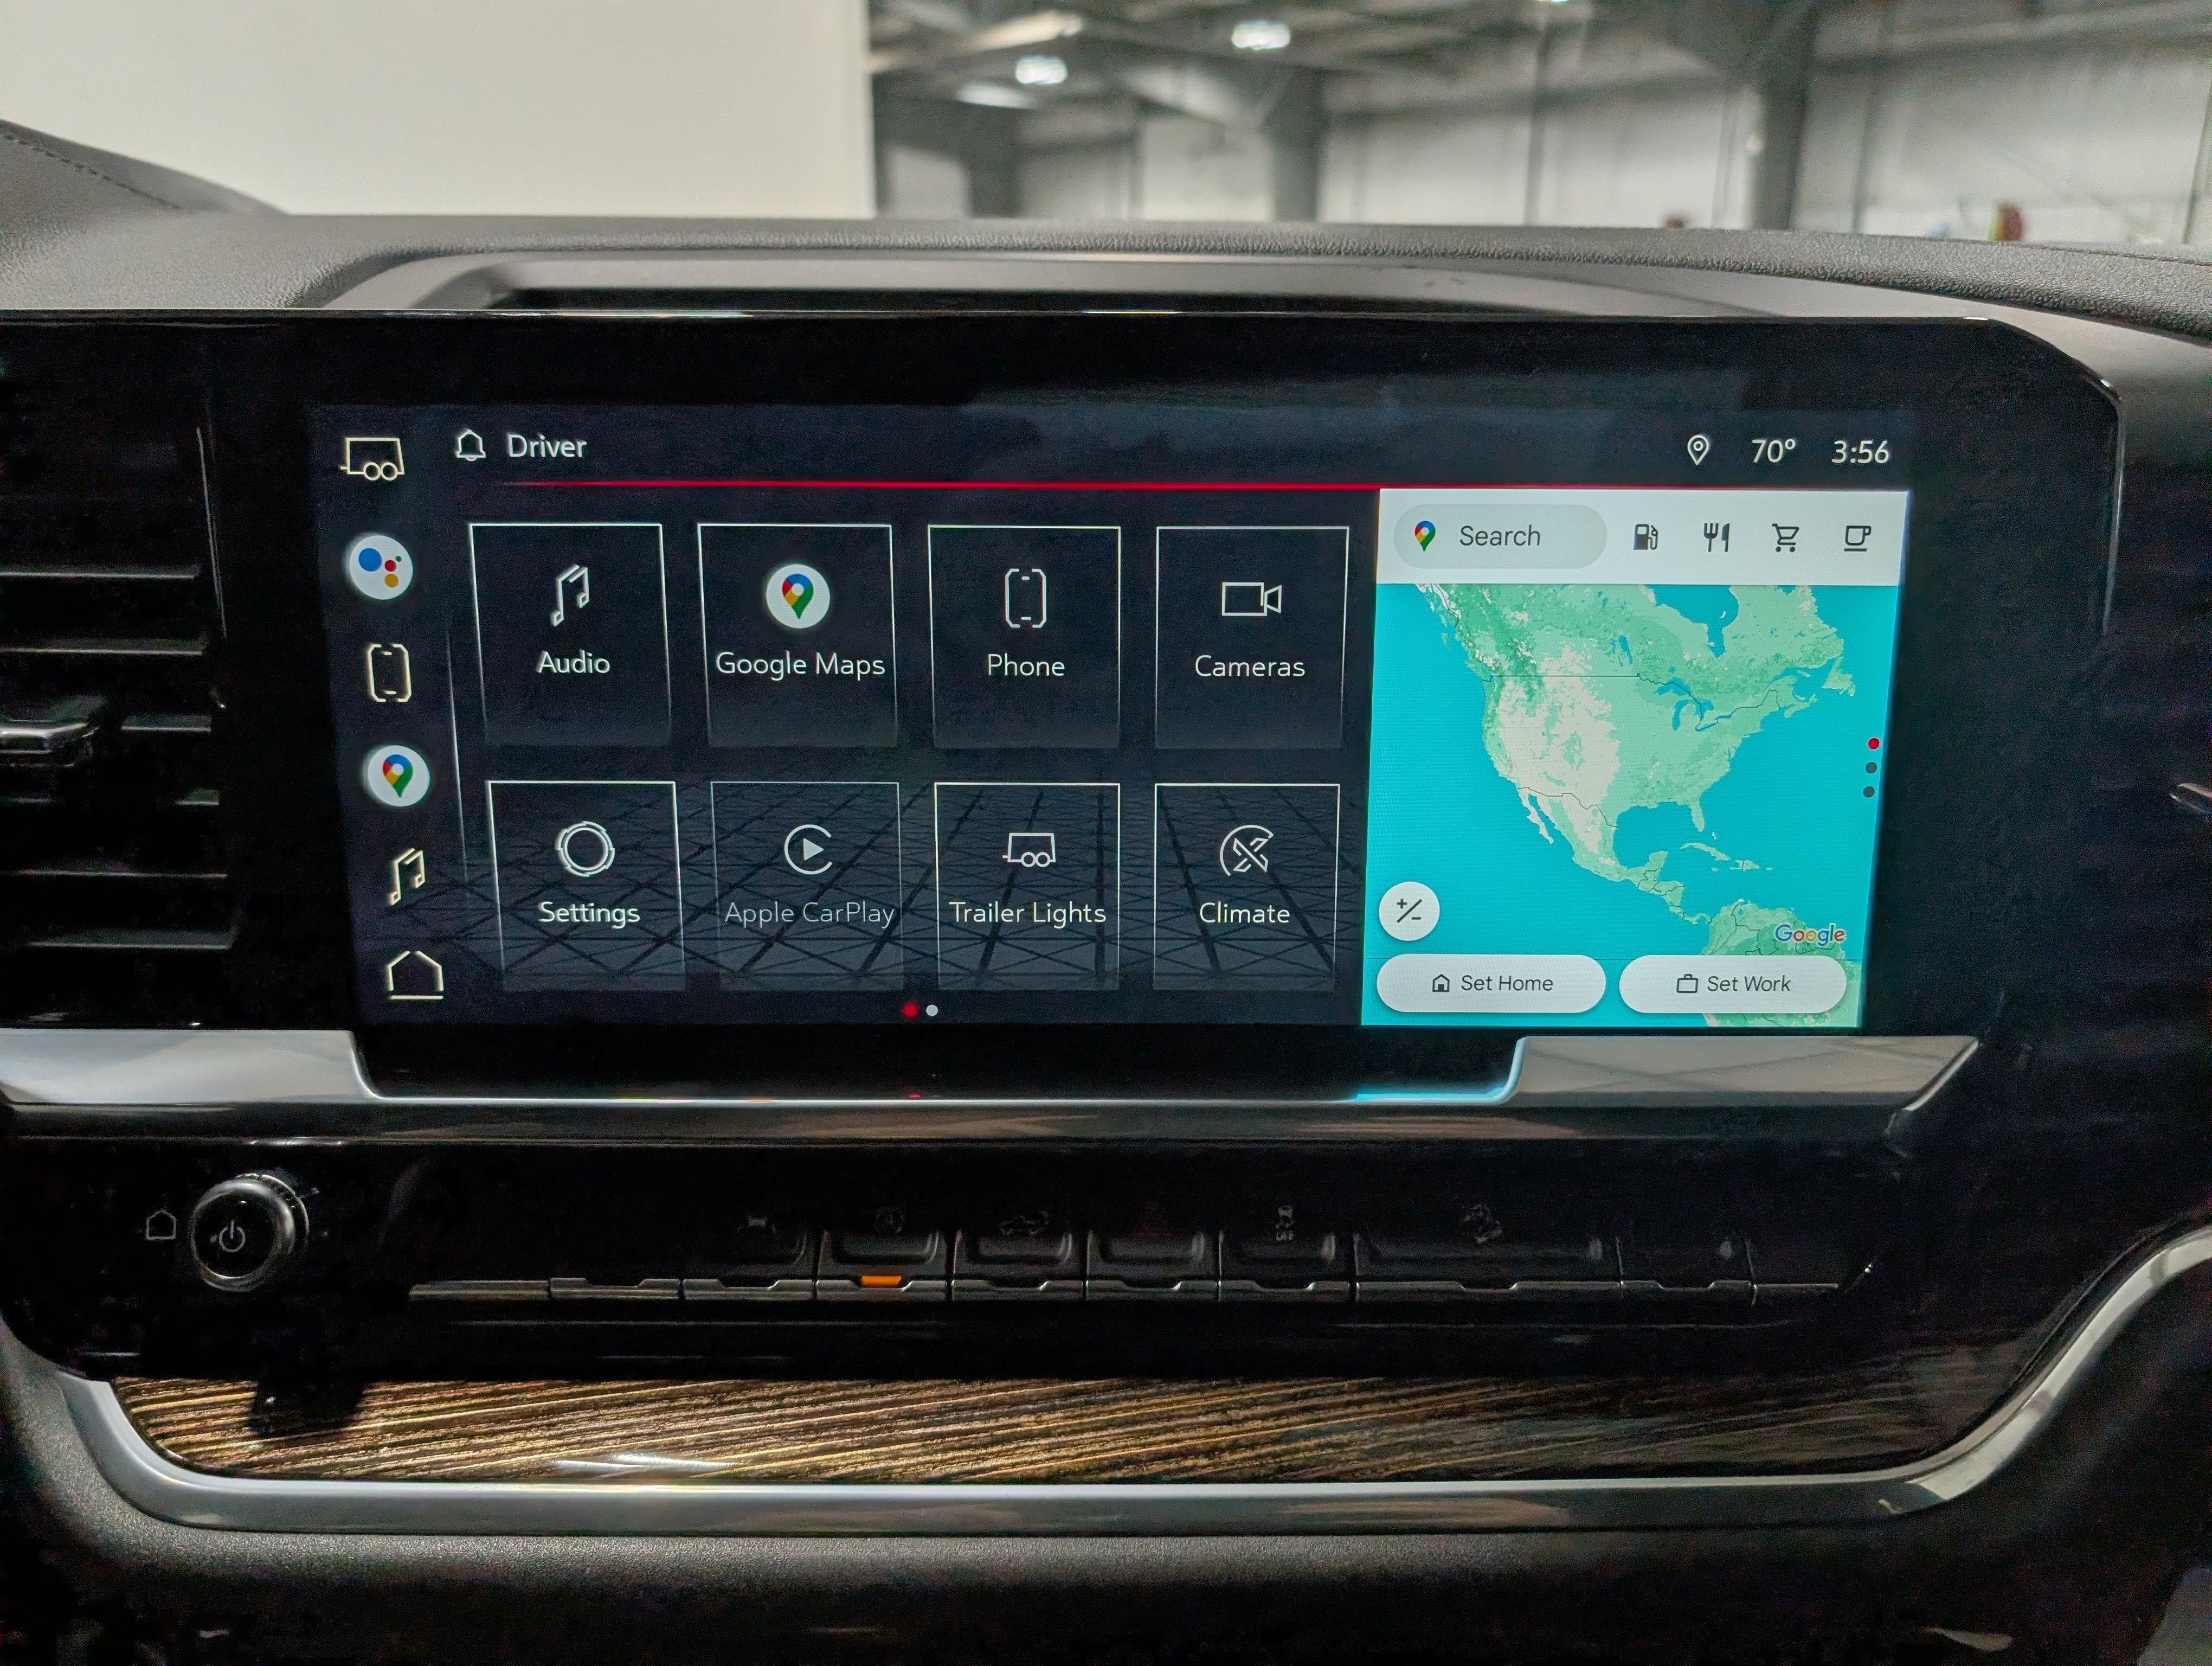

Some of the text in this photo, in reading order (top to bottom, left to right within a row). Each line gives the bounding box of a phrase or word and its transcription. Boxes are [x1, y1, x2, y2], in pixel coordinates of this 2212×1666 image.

[507, 433, 587, 458] Driver
[1752, 438, 1796, 463] 70°
[1831, 440, 1890, 464] 3:56
[1459, 524, 1540, 546] Search
[537, 649, 610, 674] Audio
[716, 650, 885, 681] Google Maps
[988, 652, 1065, 676] Phone
[1195, 655, 1306, 677] Cameras
[539, 901, 640, 929] Settings
[725, 901, 895, 929] Apple CarPlay
[949, 900, 1107, 929] Trailer Lights
[1200, 901, 1290, 923] Climate
[1774, 924, 1846, 945] Google
[1461, 975, 1553, 991] Set Home
[1707, 975, 1791, 992] Set Work
